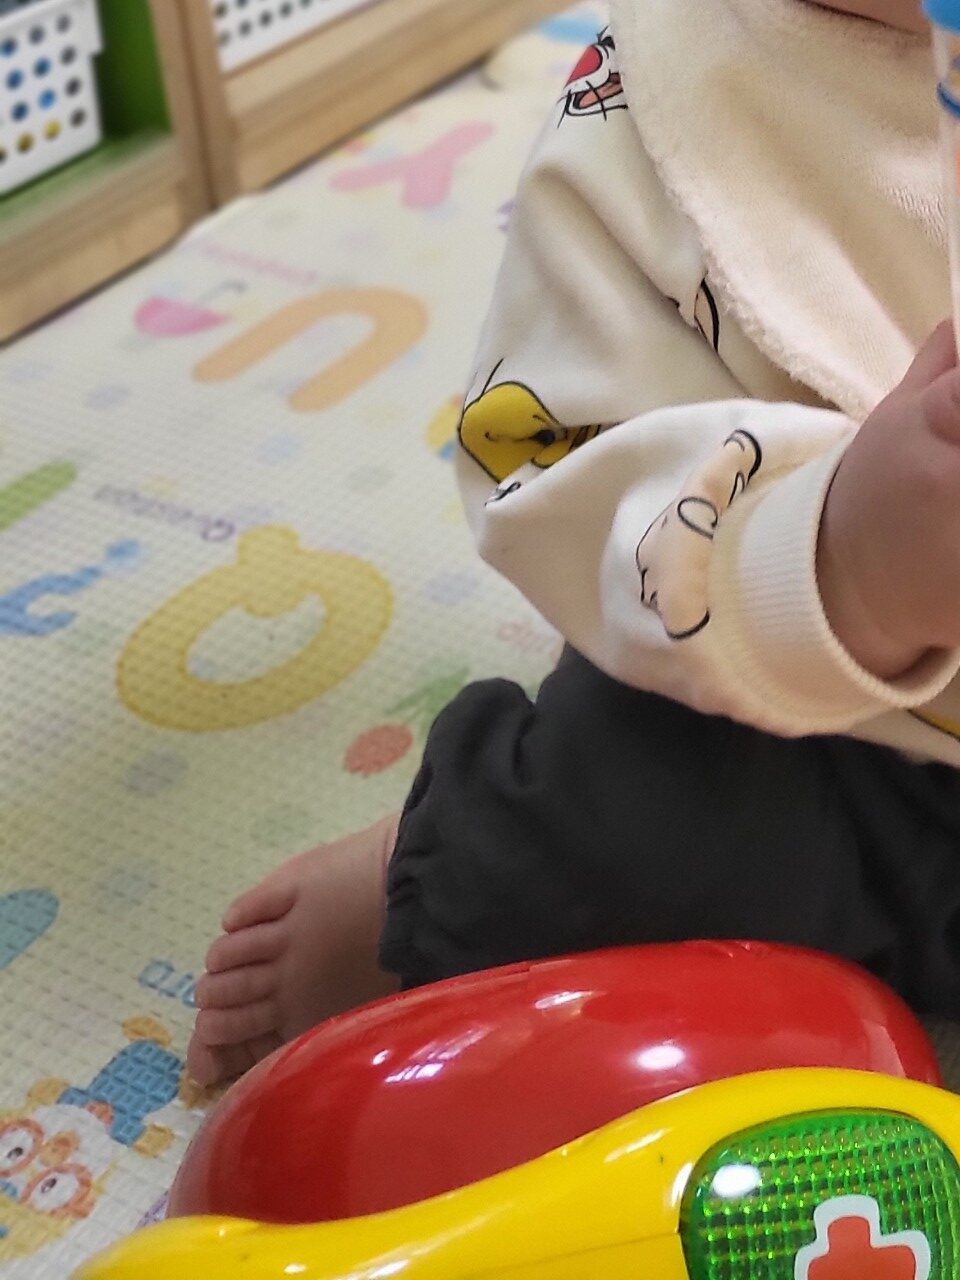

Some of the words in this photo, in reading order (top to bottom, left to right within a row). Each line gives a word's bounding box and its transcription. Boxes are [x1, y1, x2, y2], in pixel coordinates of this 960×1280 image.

[329, 124, 494, 209] Y
[189, 287, 429, 414] U
[116, 524, 394, 732] Q
